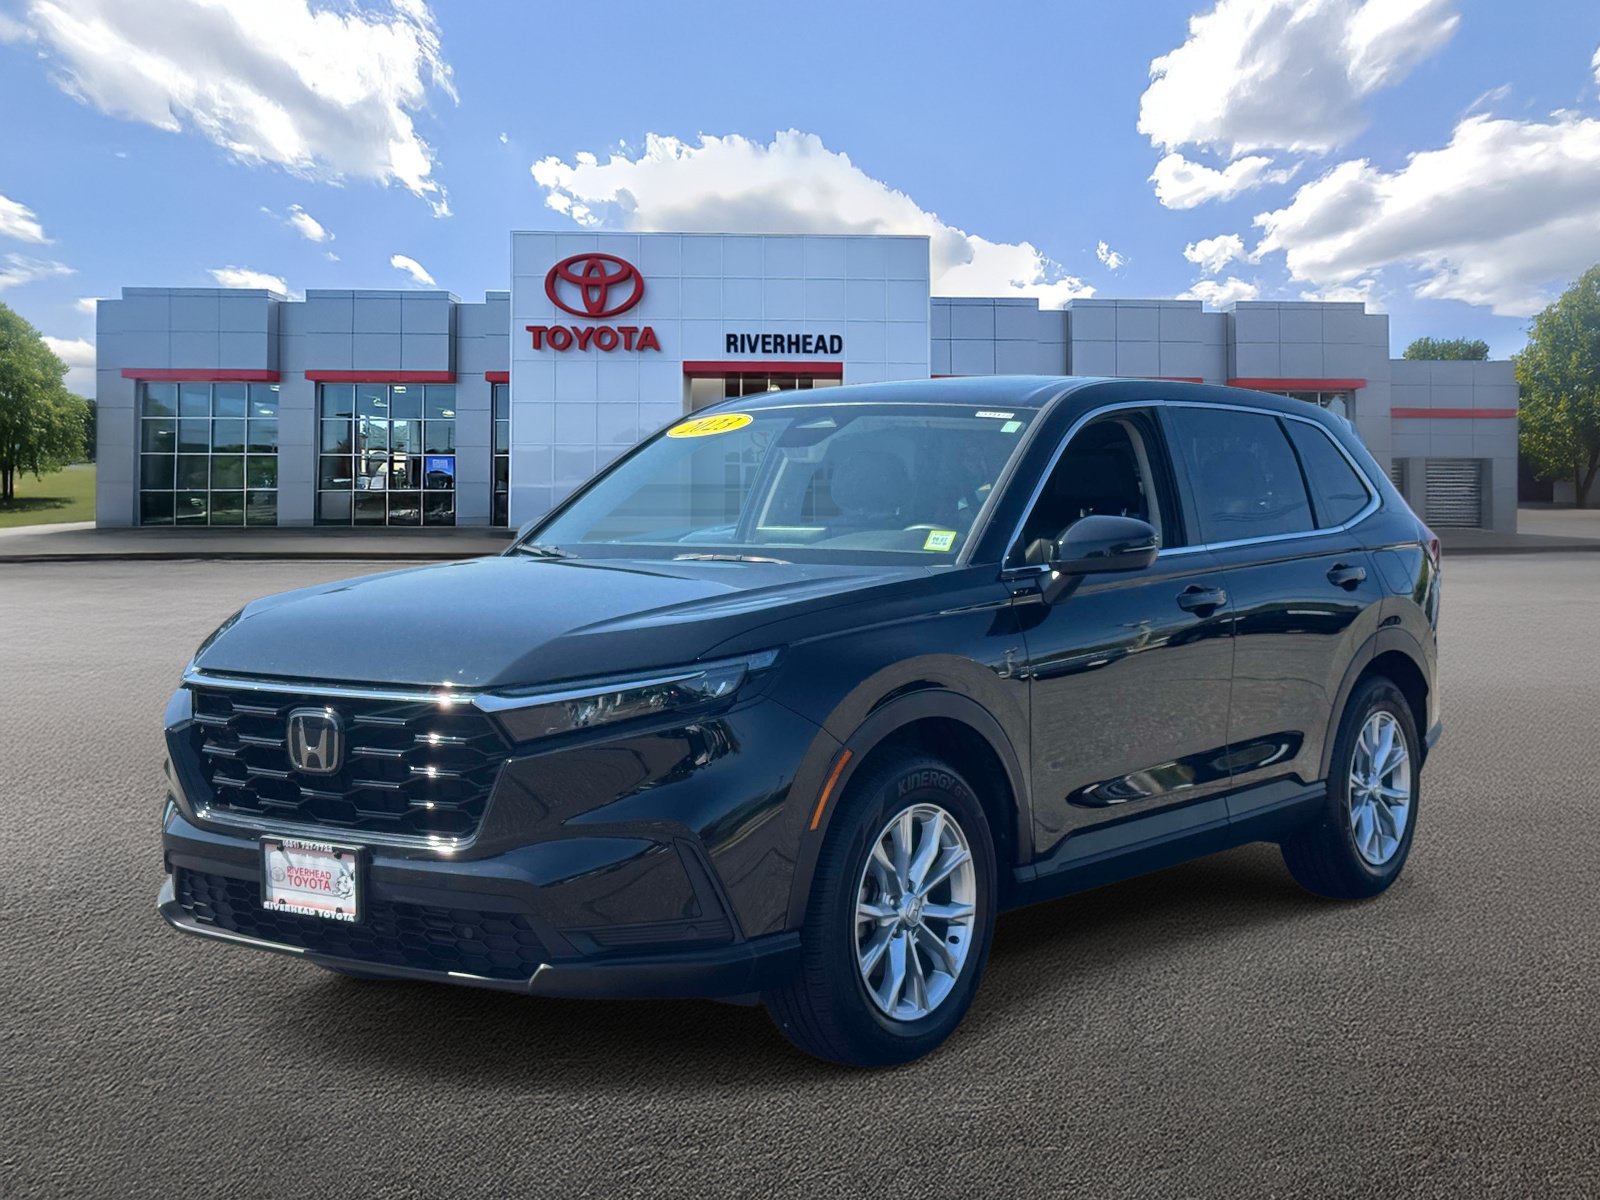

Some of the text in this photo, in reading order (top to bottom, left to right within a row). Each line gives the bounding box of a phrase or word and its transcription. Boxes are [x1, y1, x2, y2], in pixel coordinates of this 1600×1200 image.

[526, 325, 661, 352] TOYOTA
[726, 333, 843, 355] RIVERHEAD
[897, 770, 956, 798] KINERGY
[286, 865, 332, 880] RIVERHEAD
[287, 874, 332, 891] TOYOTA
[263, 901, 355, 922] RIVERHEAD TOYOTA
